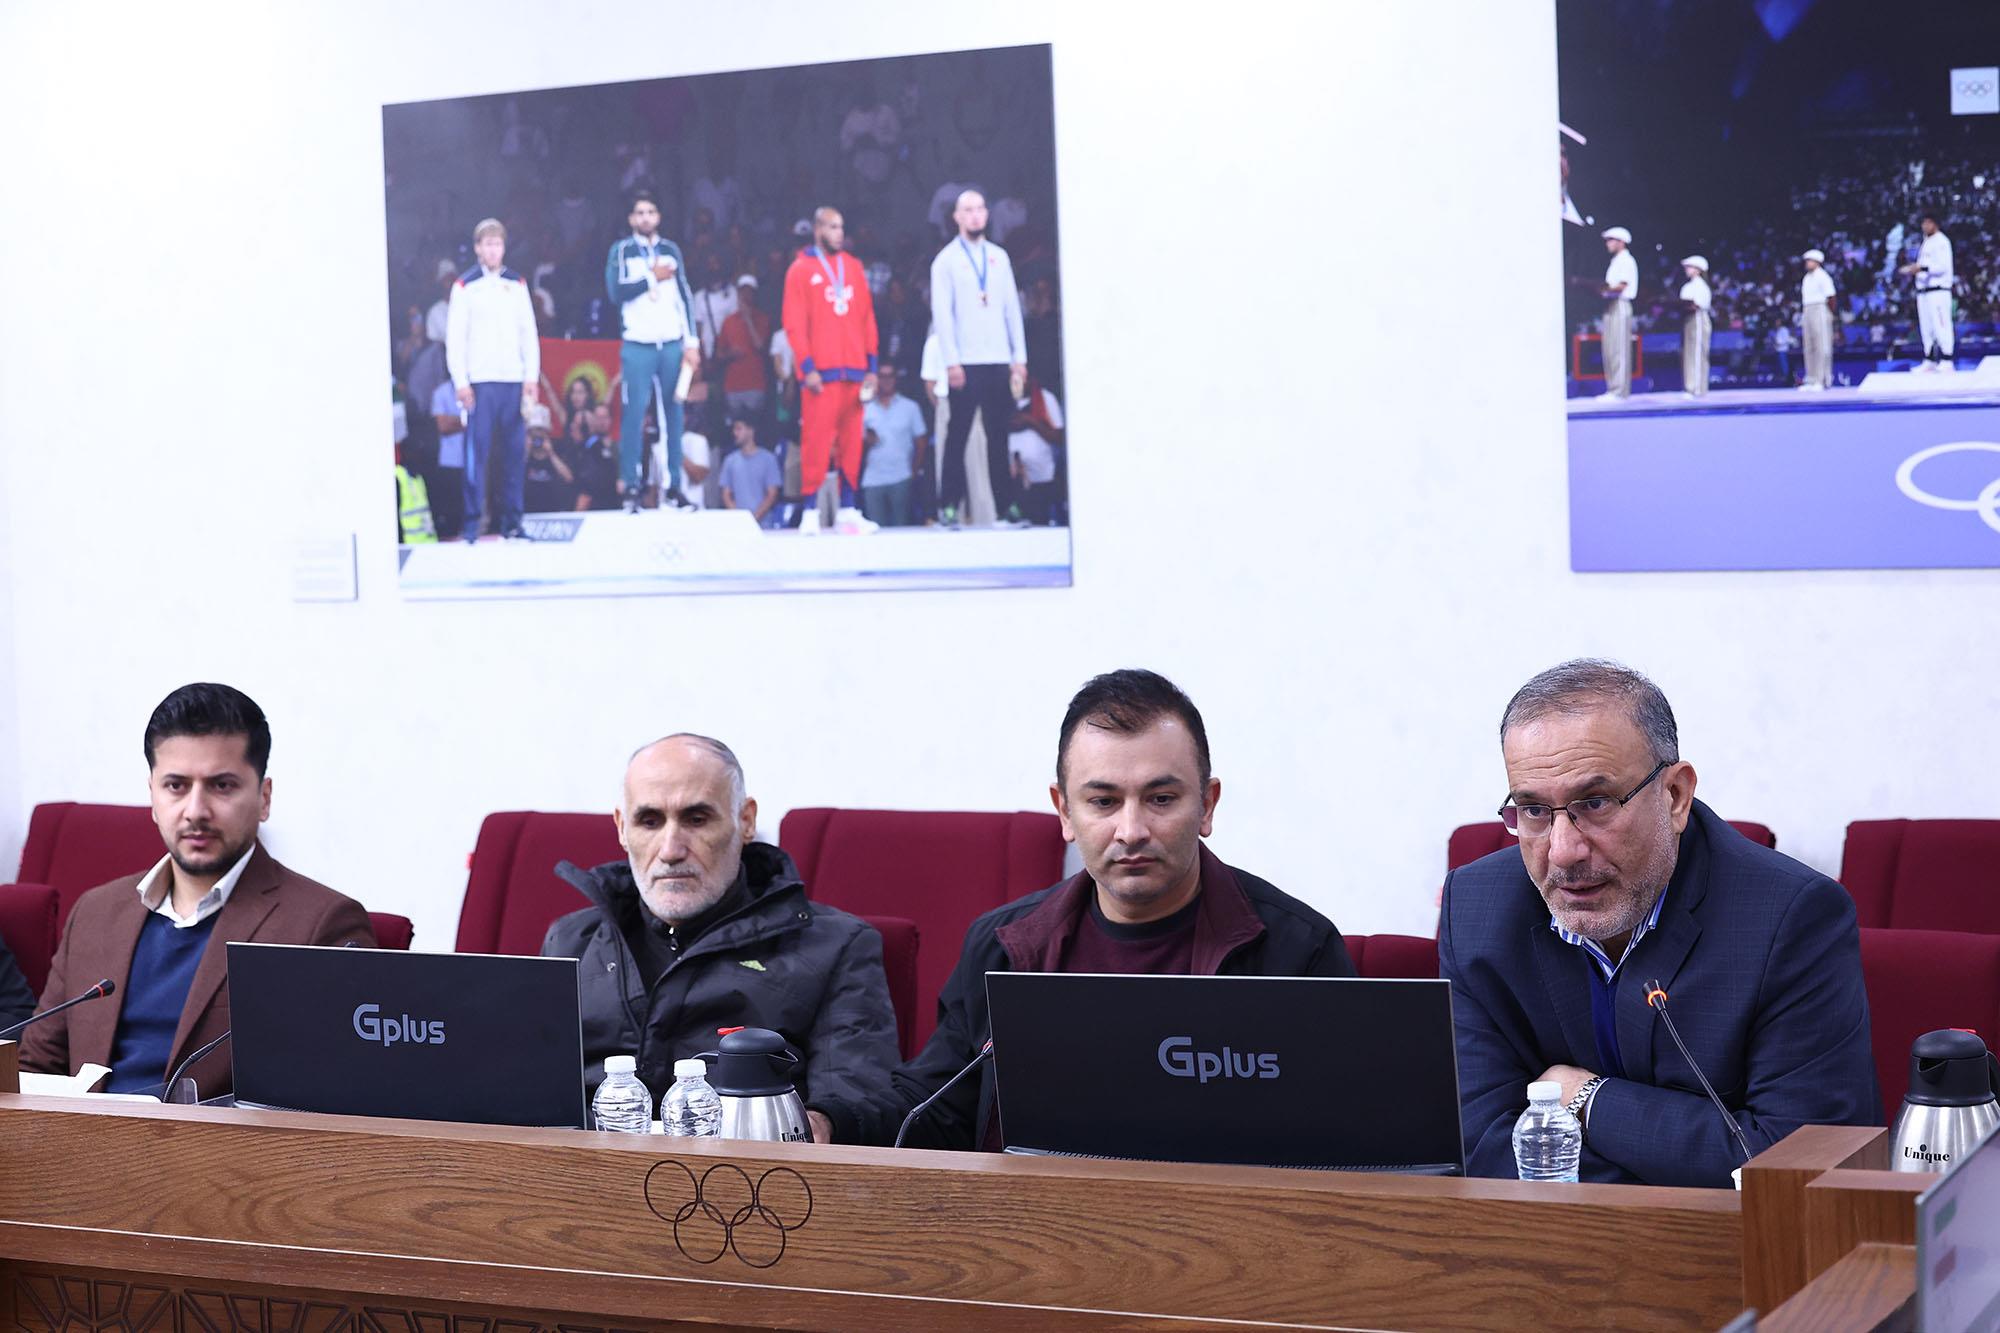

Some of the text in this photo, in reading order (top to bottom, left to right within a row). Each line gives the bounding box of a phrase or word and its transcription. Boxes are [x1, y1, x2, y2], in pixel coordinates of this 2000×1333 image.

[352, 1003, 446, 1047] Gplus
[1157, 1036, 1280, 1083] Gplus
[1904, 1144, 1951, 1163] Unique
